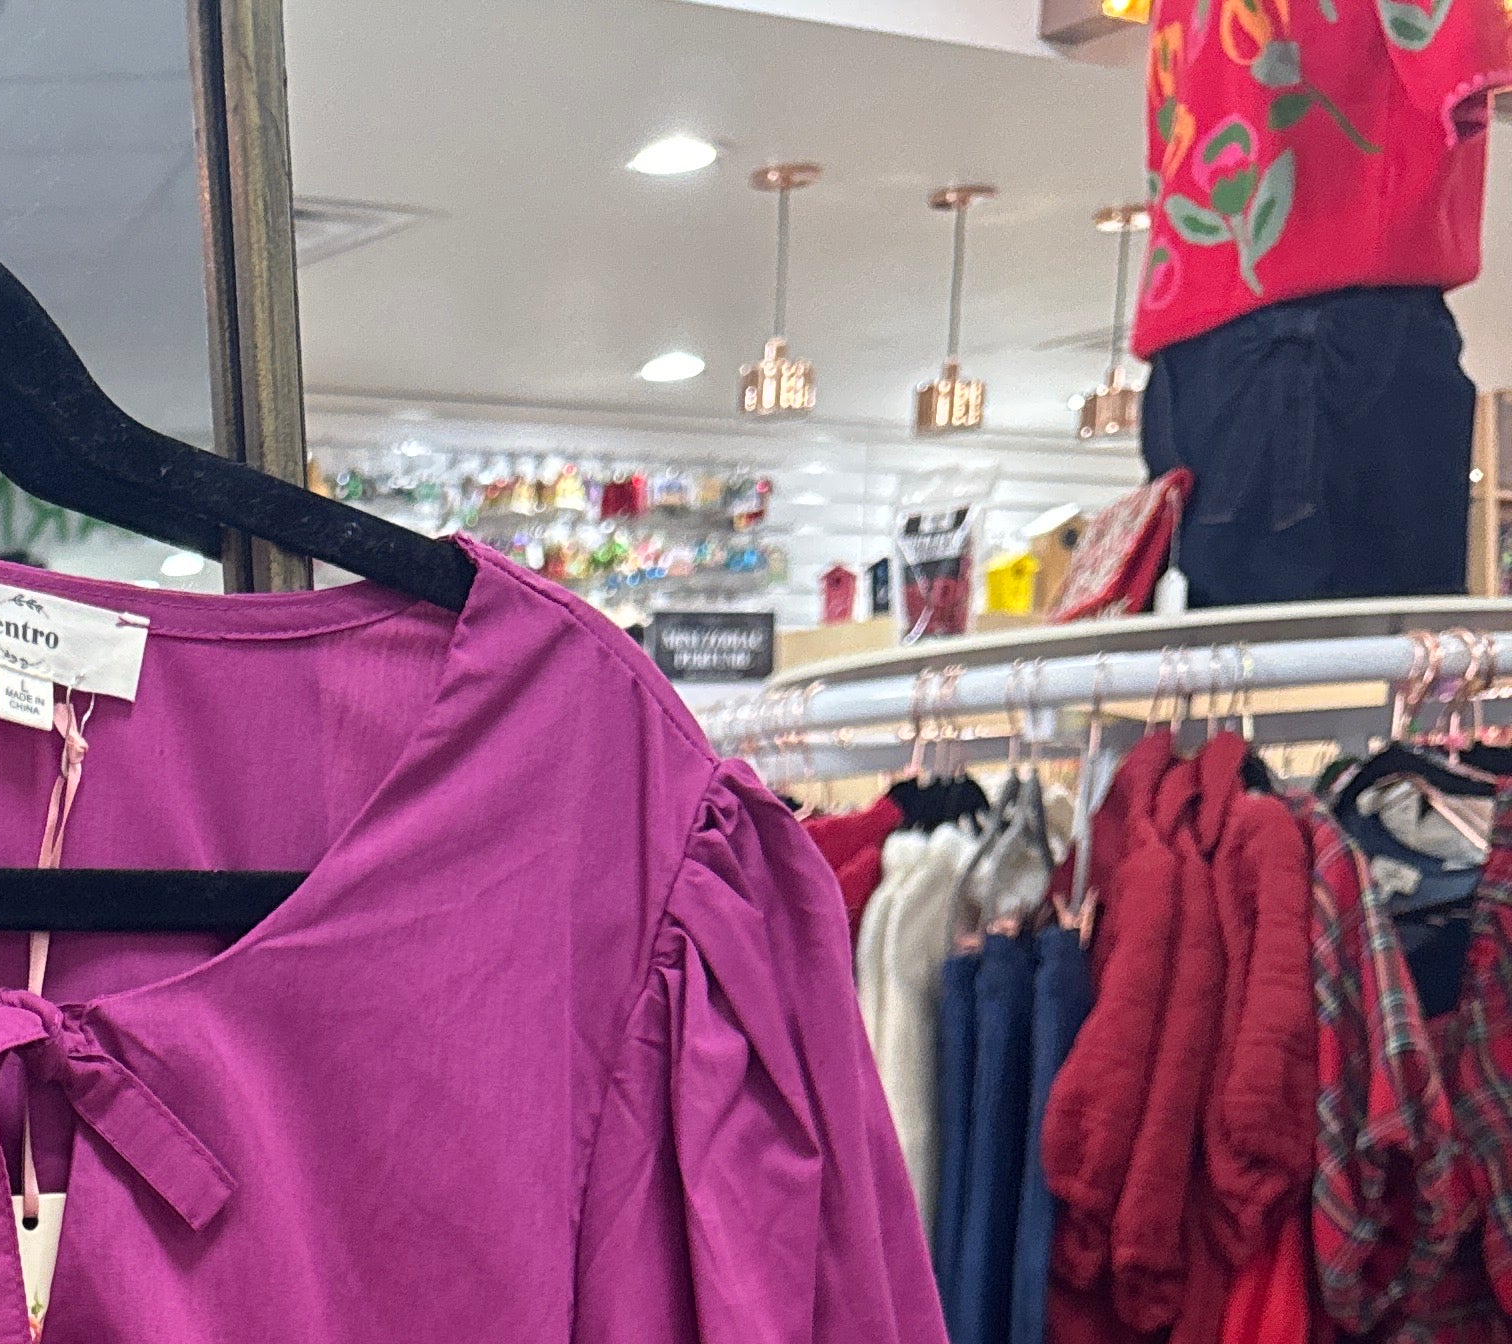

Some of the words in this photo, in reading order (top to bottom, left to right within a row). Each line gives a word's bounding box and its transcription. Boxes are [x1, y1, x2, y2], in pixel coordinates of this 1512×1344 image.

[20, 679, 29, 693] L
[5, 687, 33, 703] MADE
[35, 696, 45, 706] IN
[9, 700, 40, 715] CHINA
